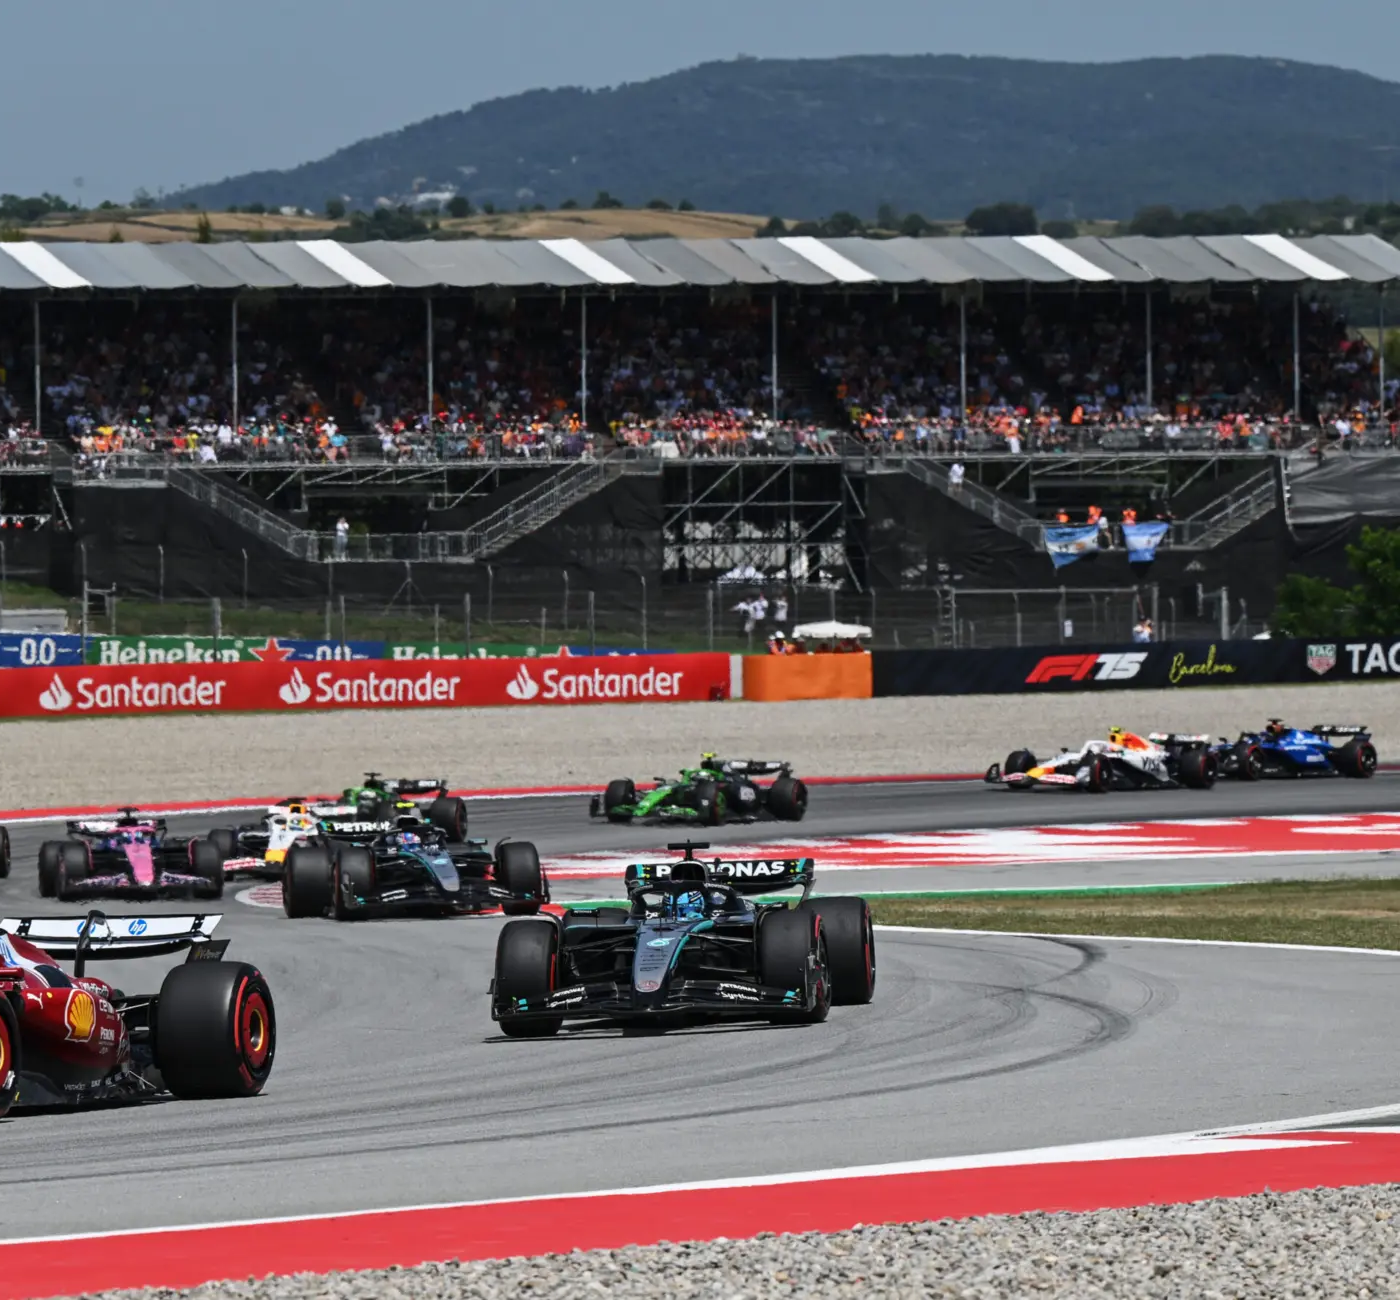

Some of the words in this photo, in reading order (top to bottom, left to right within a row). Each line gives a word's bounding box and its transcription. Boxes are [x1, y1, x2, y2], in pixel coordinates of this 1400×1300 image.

[1169, 644, 1237, 683] Barcelona
[76, 676, 226, 709] Santander
[315, 672, 461, 703] Santander
[542, 667, 683, 699] Santander
[128, 919, 148, 936] hp
